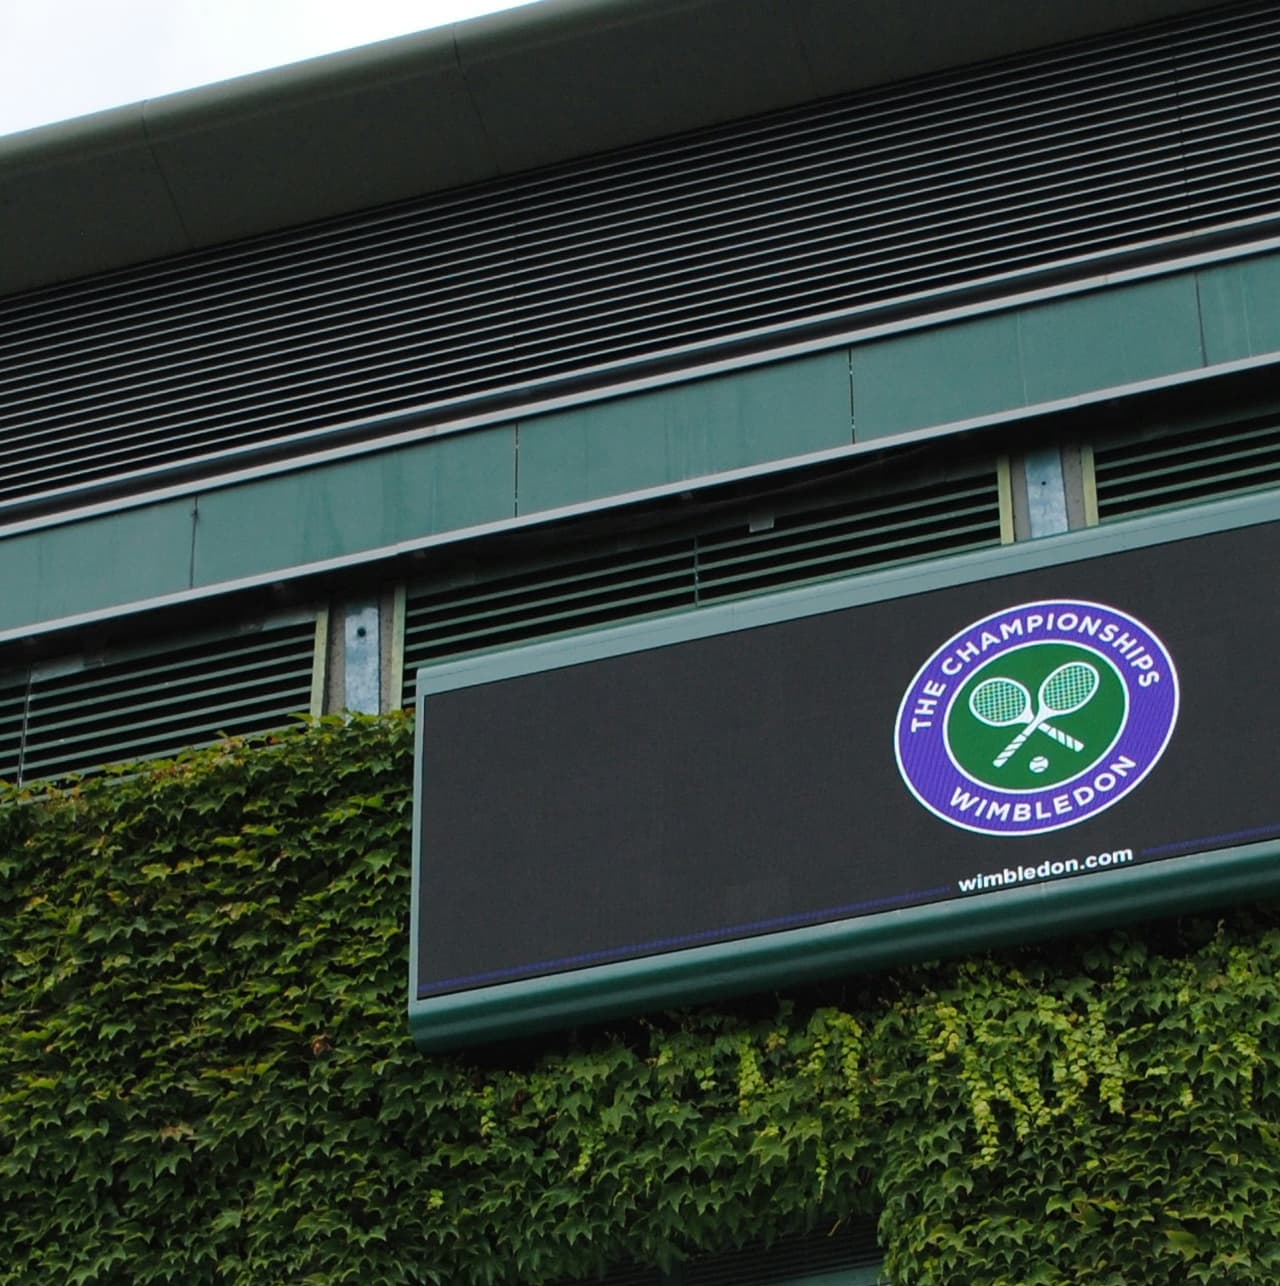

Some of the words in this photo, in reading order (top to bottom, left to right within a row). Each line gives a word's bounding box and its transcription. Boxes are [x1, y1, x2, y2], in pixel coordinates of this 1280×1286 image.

[911, 680, 947, 732] THE
[942, 612, 1160, 687] CHAMPIONSHIPS
[950, 755, 1136, 822] WIMBLEDON
[958, 848, 1133, 892] wimbledon.com
